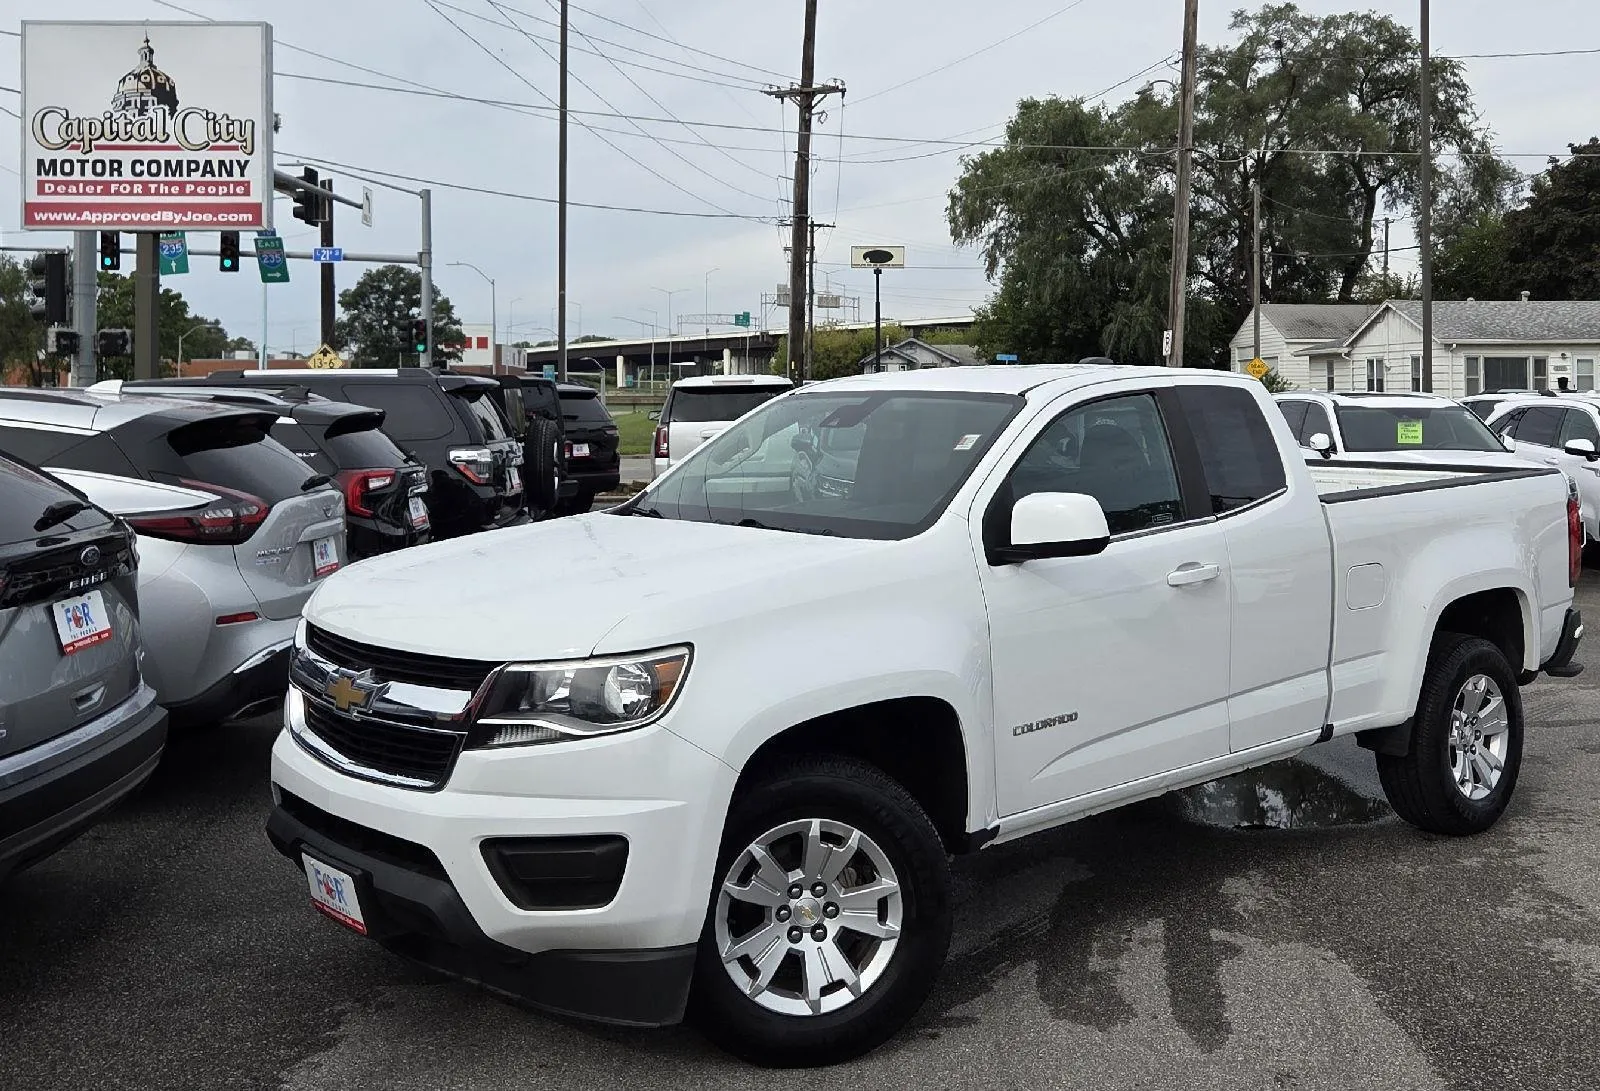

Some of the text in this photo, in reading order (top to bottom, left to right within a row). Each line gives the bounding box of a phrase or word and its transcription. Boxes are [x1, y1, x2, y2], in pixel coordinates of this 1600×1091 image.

[32, 106, 254, 155] Capital City
[37, 158, 250, 178] MOTOR COMPANY
[44, 183, 245, 195] Dealer FOR The People
[33, 210, 253, 224] www.ApprovedByJoe.com
[162, 243, 182, 255] 235
[258, 240, 280, 248] EAST
[263, 253, 282, 264] 235
[1012, 711, 1079, 737] COLORADO
